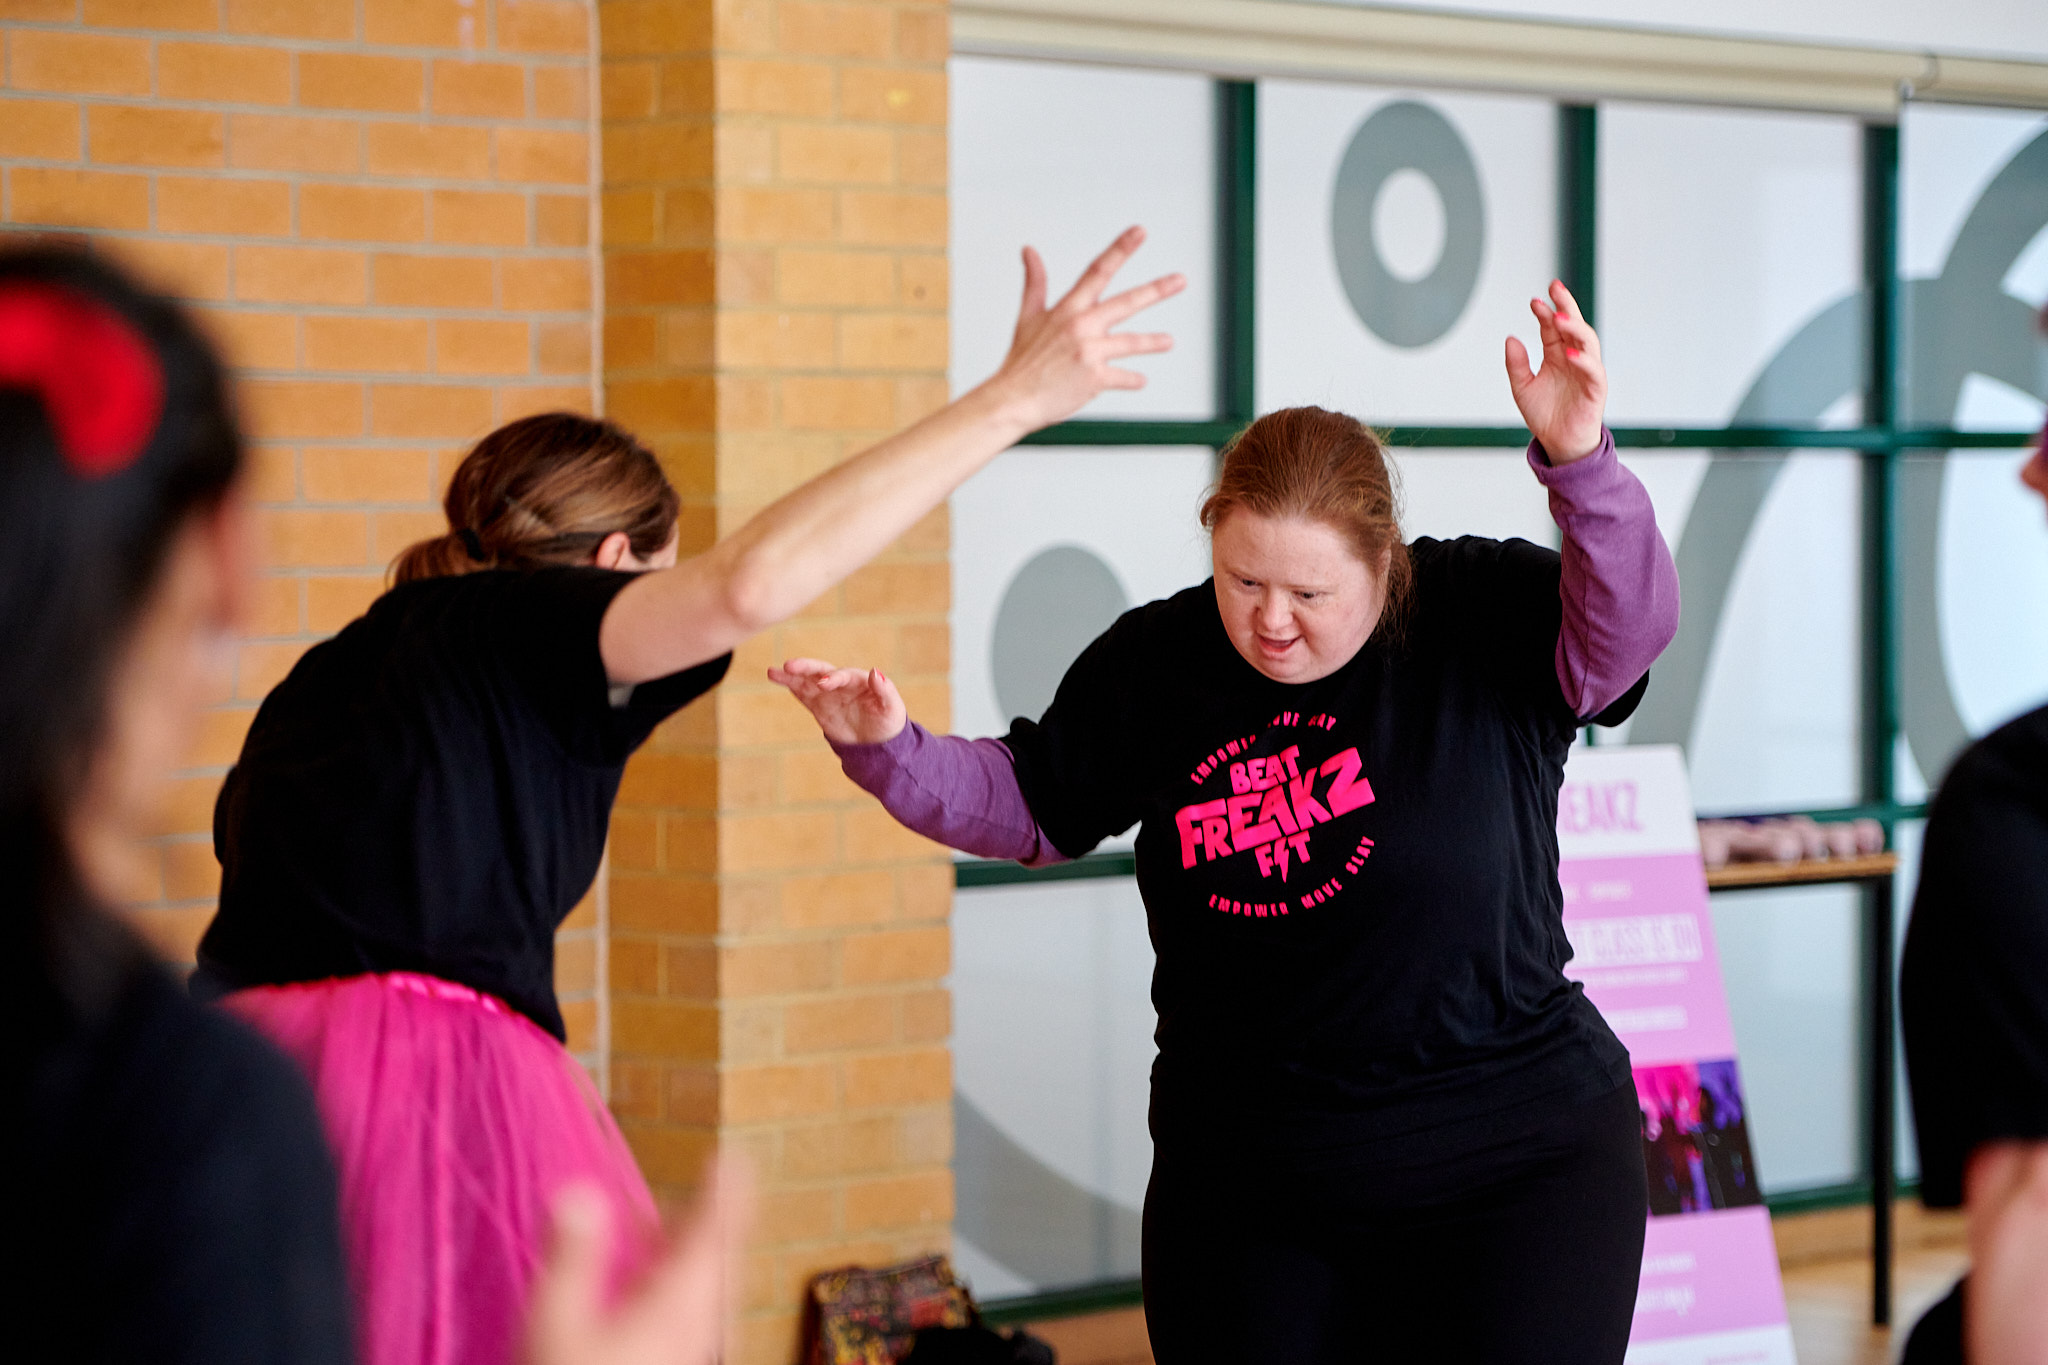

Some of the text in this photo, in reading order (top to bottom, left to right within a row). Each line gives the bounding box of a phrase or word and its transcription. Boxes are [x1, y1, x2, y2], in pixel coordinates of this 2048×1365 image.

[1267, 711, 1300, 728] OVE
[1229, 744, 1300, 795] BEAT
[1175, 747, 1376, 869] FREAKZ
[1208, 836, 1375, 918] EMPOWER MOVE SLAY
[1254, 830, 1311, 883] FIT
